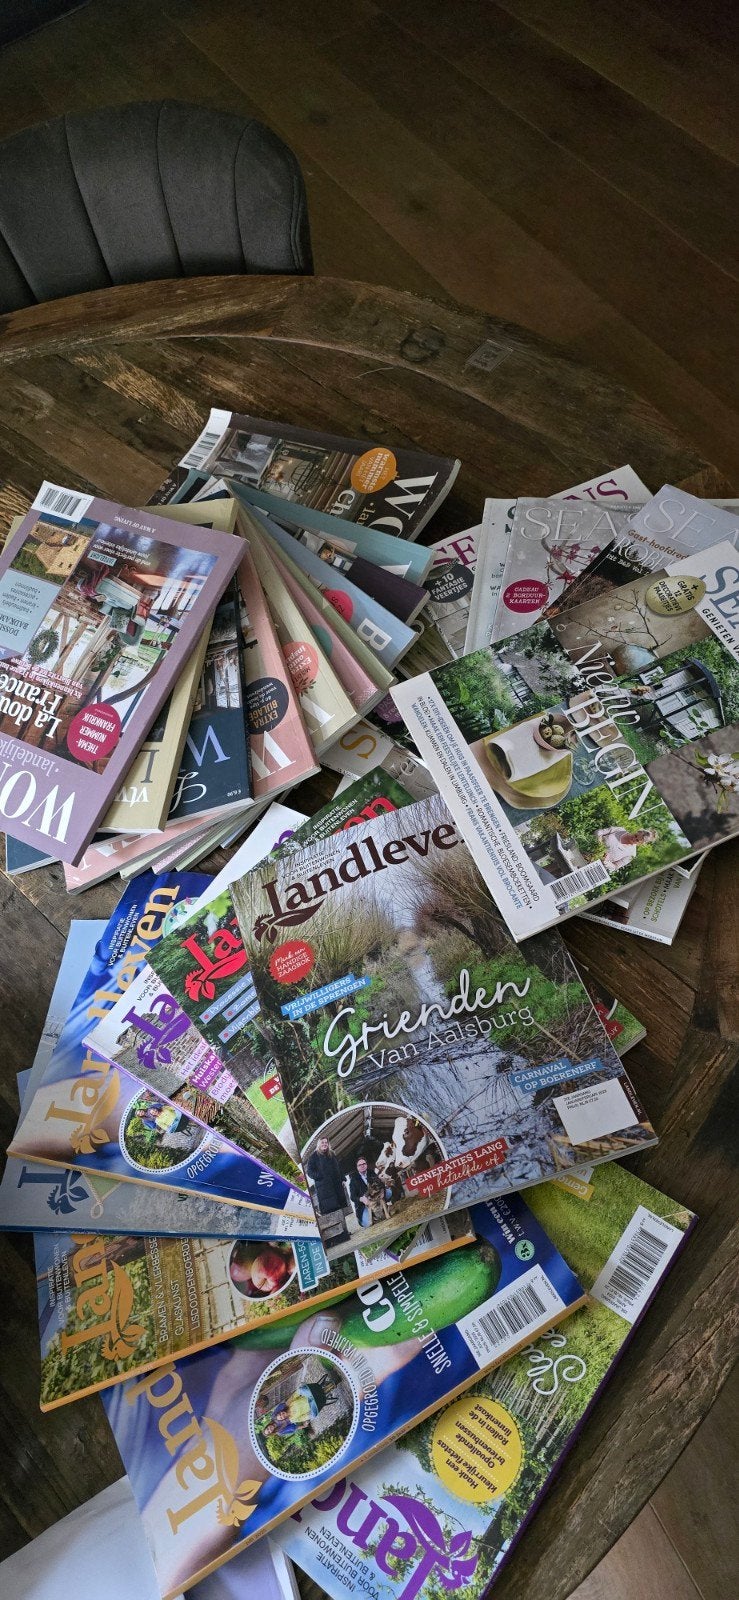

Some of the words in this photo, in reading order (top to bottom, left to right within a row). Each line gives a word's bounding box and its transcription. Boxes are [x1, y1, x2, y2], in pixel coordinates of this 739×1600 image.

[431, 576, 464, 594] FANTASIE
[434, 582, 467, 600] VEERTJES
[442, 572, 454, 582] 10
[677, 580, 695, 602] GRATIS
[654, 585, 673, 612] PAASEITJES
[659, 580, 682, 611] DECORATIEVE
[673, 589, 681, 597] 12
[702, 607, 735, 644] GENIETEN
[0, 672, 62, 715] France
[566, 640, 641, 723] Nieuw
[82, 712, 116, 732] FRANKRIJK
[247, 699, 278, 720] BIJLAGE
[253, 709, 278, 728] EXTRA
[33, 710, 62, 738] La
[78, 725, 107, 743] NUMMER
[446, 733, 454, 743] OM
[75, 737, 98, 754] THEMA-
[449, 741, 457, 749] JE
[453, 747, 464, 760] HUIS
[560, 688, 663, 821] BEGIN
[464, 765, 483, 796] PAASSFEER
[479, 795, 487, 803] TE
[303, 829, 319, 844] VOOR
[319, 798, 358, 831] BUITENWONEN
[312, 805, 341, 830] INSPIRATIE
[316, 808, 355, 839] BUITENLEVEN
[424, 729, 439, 752] KLIMMEN
[436, 750, 443, 758] EN
[440, 757, 451, 774] DALEN
[451, 779, 467, 804] LIMBURG
[465, 807, 478, 825] FRANS
[475, 825, 500, 866] VAKANTIEHUIS
[496, 865, 506, 878] VOL
[502, 877, 522, 909] BROCANTE
[483, 802, 501, 828] BRENGEN
[456, 770, 478, 804] LENTELUNCH
[476, 807, 500, 847] ROMANTISCHE
[497, 847, 531, 905] BLOESEMBOEKETTEN
[261, 820, 465, 924] Landleve
[281, 868, 298, 879] VOOR
[298, 848, 340, 871] BUITENWONEN
[294, 850, 323, 868] INSPIRATIE
[296, 856, 334, 878] BUITENLEVEN
[515, 862, 539, 901] BOOMGAARD
[650, 892, 666, 922] SCHOTELS
[108, 916, 125, 950] INSPIRATIE
[108, 947, 119, 966] VOOR
[115, 903, 137, 947] BUITENWONEN
[119, 911, 140, 953] BUITENLEVEN
[276, 951, 307, 972] HANDIGE
[278, 957, 310, 977] ZAAGBOK
[136, 983, 152, 1001] VOOR
[284, 977, 351, 1011] VRIJWILLIGERS
[292, 1007, 303, 1016] IN
[304, 1001, 317, 1011] DE
[318, 978, 366, 1004] SPRENGEN
[324, 968, 529, 1077] Grienden
[367, 1041, 419, 1068] Van
[423, 1006, 534, 1049] Aalsburg
[513, 1061, 566, 1082] CARNAVAL
[524, 1080, 538, 1091] OP
[539, 1061, 597, 1085] BOERENERF
[409, 1153, 473, 1186] GENERATIES
[474, 1141, 503, 1158] LANG
[422, 1184, 432, 1196] op
[486, 1153, 499, 1166] erf
[489, 1206, 503, 1224] een
[507, 1214, 525, 1237] t.w.v.
[499, 1222, 516, 1244] Win
[312, 1246, 321, 1259] DE
[53, 1243, 62, 1298] BUITENWONEN
[62, 1250, 70, 1302] BUITENLEVEN
[315, 1262, 322, 1272] IN
[171, 1279, 184, 1334] GLASKUNST
[157, 1301, 168, 1341] BRAMEN
[409, 1317, 430, 1333] &
[321, 1328, 356, 1360] VRIJHEID
[417, 1327, 452, 1374] SNELLE
[359, 1371, 377, 1431] OPGEGROEID
[468, 1410, 478, 1420] de
[474, 1403, 511, 1436] linnenkast
[476, 1418, 486, 1427] in
[483, 1424, 508, 1445] Rollen
[436, 1439, 463, 1464] fietstas
[445, 1458, 459, 1472] een
[457, 1470, 478, 1489] Haak
[462, 1461, 496, 1493] kleurrijke
[303, 1525, 358, 1579] BUITENWONEN
[318, 1525, 369, 1574] BUITENLEVEN
[315, 1551, 356, 1592] INSPIRATIE
[356, 1575, 378, 1599] VOOR
